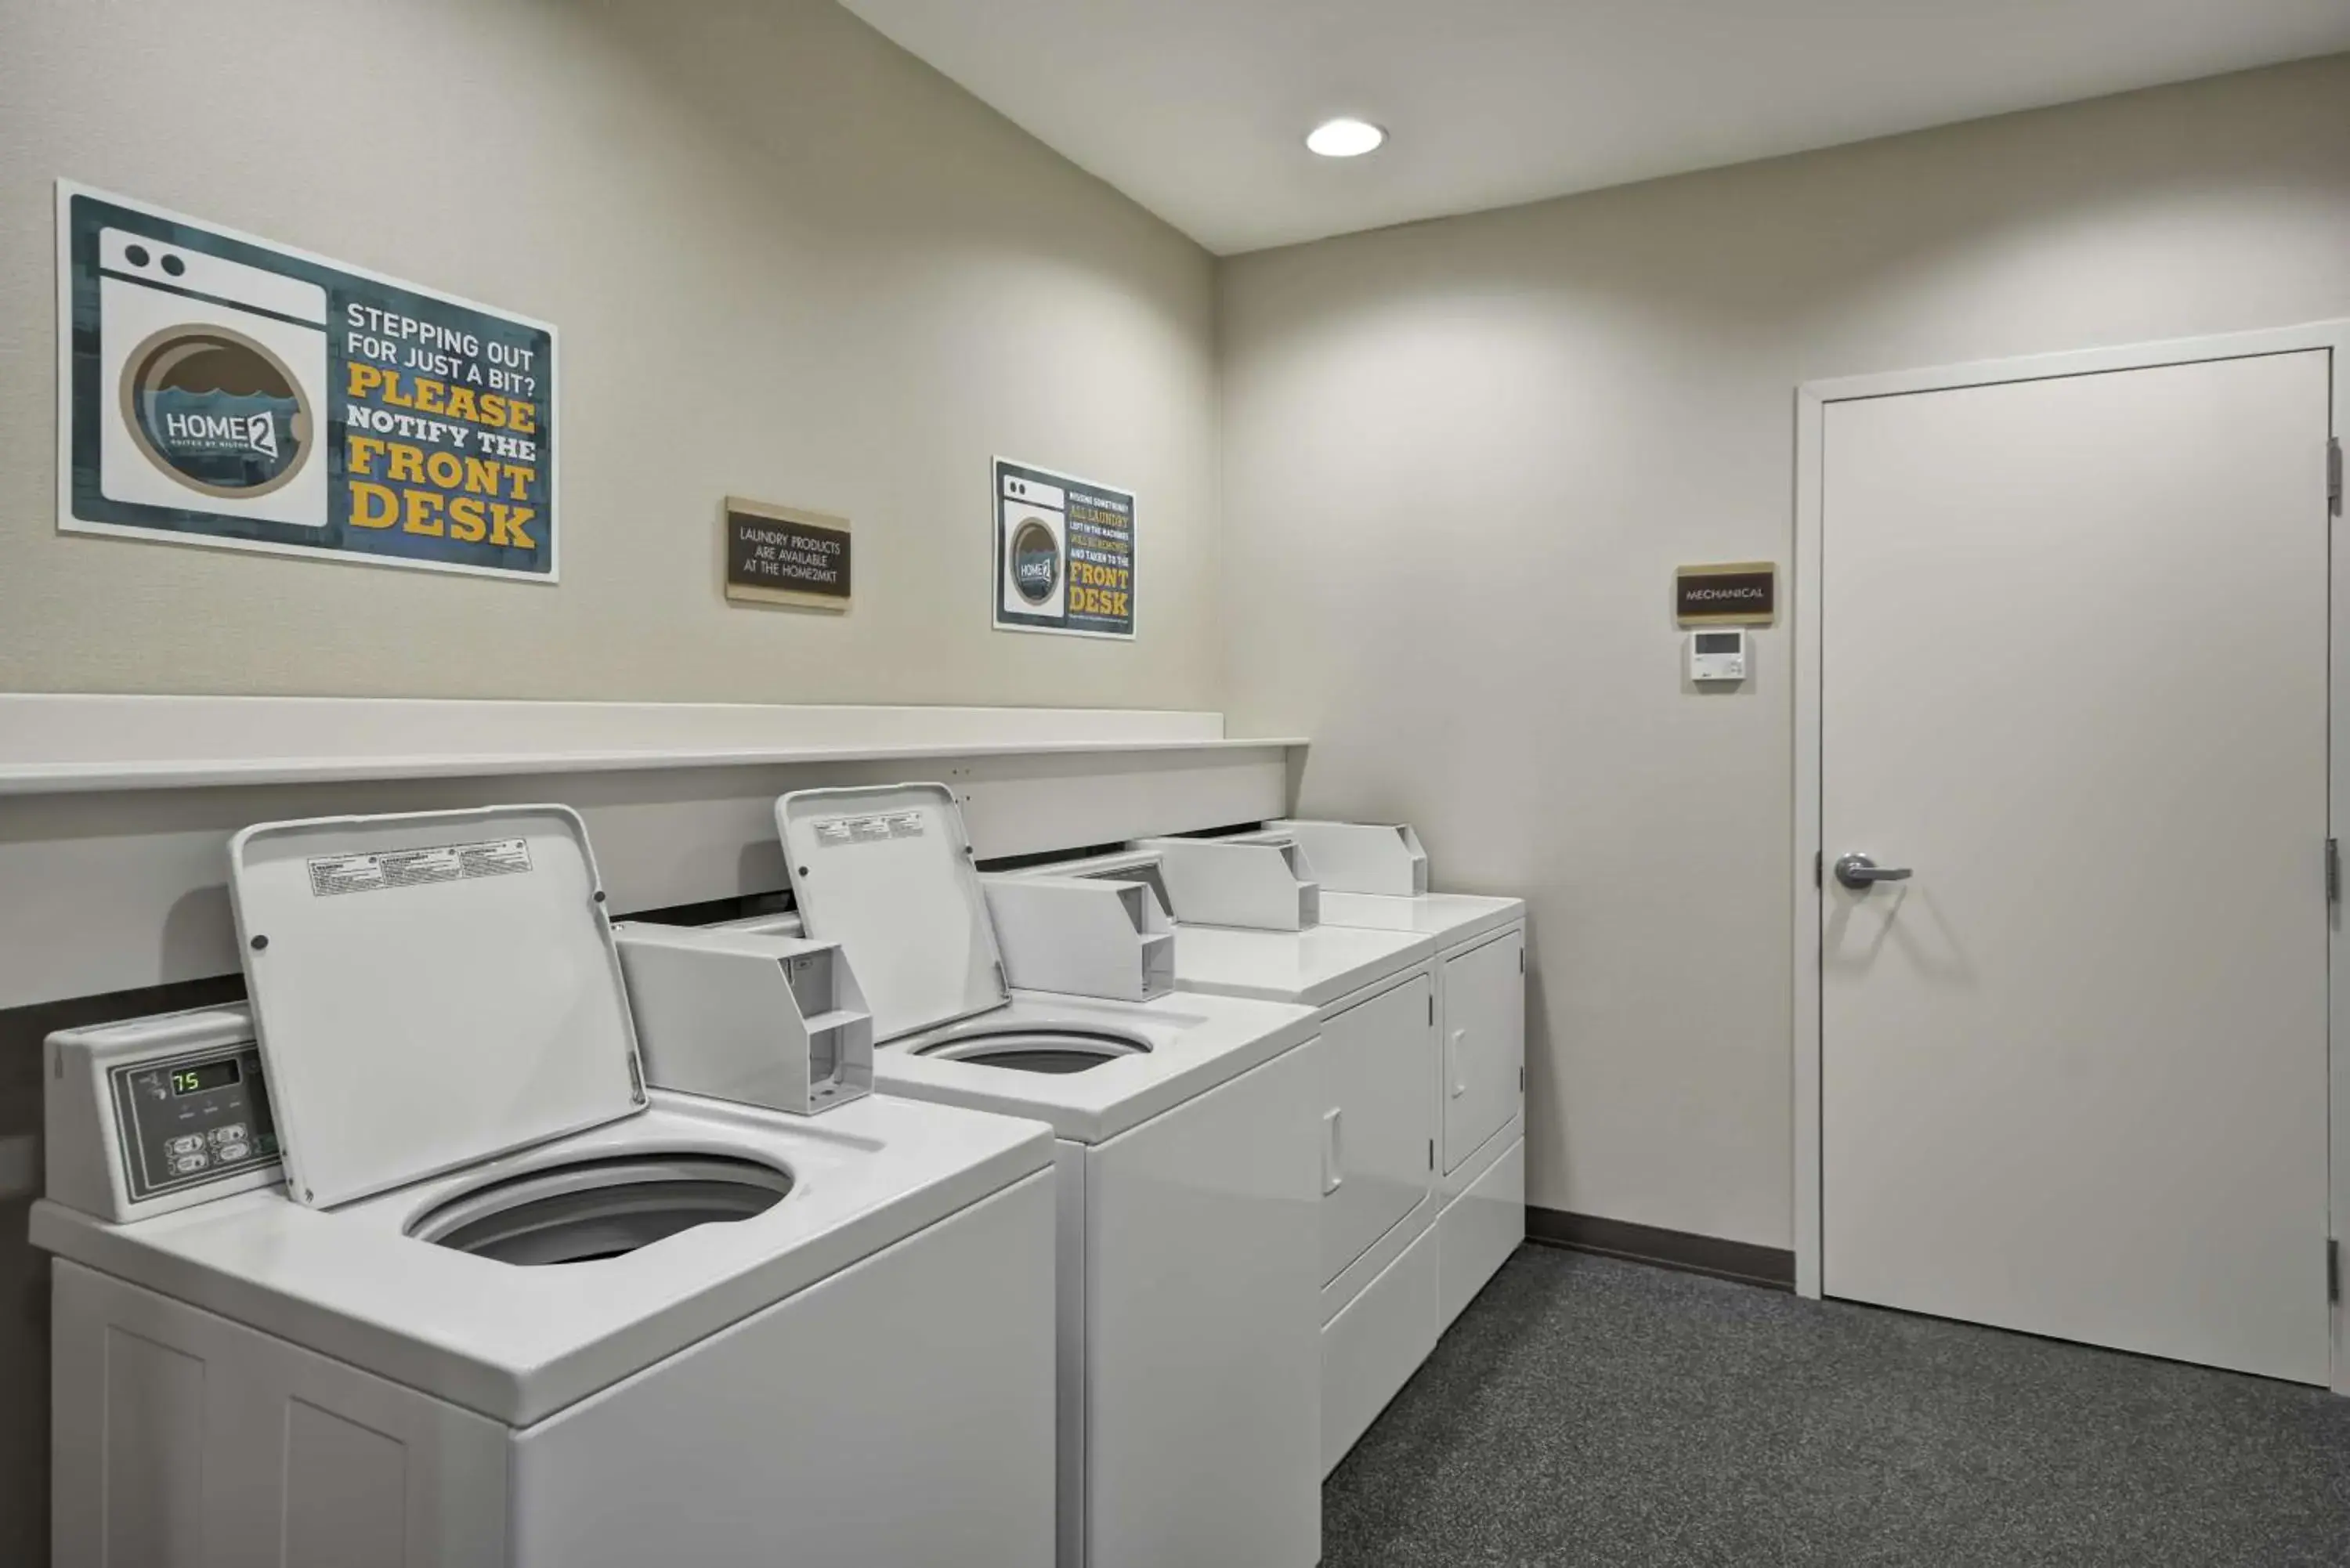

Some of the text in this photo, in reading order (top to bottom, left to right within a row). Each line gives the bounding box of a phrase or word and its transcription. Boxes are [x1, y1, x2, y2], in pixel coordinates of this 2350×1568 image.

[348, 303, 533, 371] STEPPING OUT
[348, 332, 536, 397] FOR JUST A BIT?
[347, 361, 536, 434] PLEASE
[347, 404, 536, 461] NOTIFY THE
[348, 435, 535, 500] FRONT
[349, 480, 536, 549] DESK
[740, 526, 841, 555] LAUNDRY PRODUCTS
[754, 545, 828, 567] ARE AVAILABLE
[743, 558, 757, 573] AT
[761, 560, 780, 576] THE
[1086, 550, 1107, 564] TAKEN
[1070, 559, 1128, 590] FRONT
[1070, 585, 1128, 616] DESK
[1687, 587, 1764, 600] MECHANICAL
[173, 1071, 199, 1092] 75
